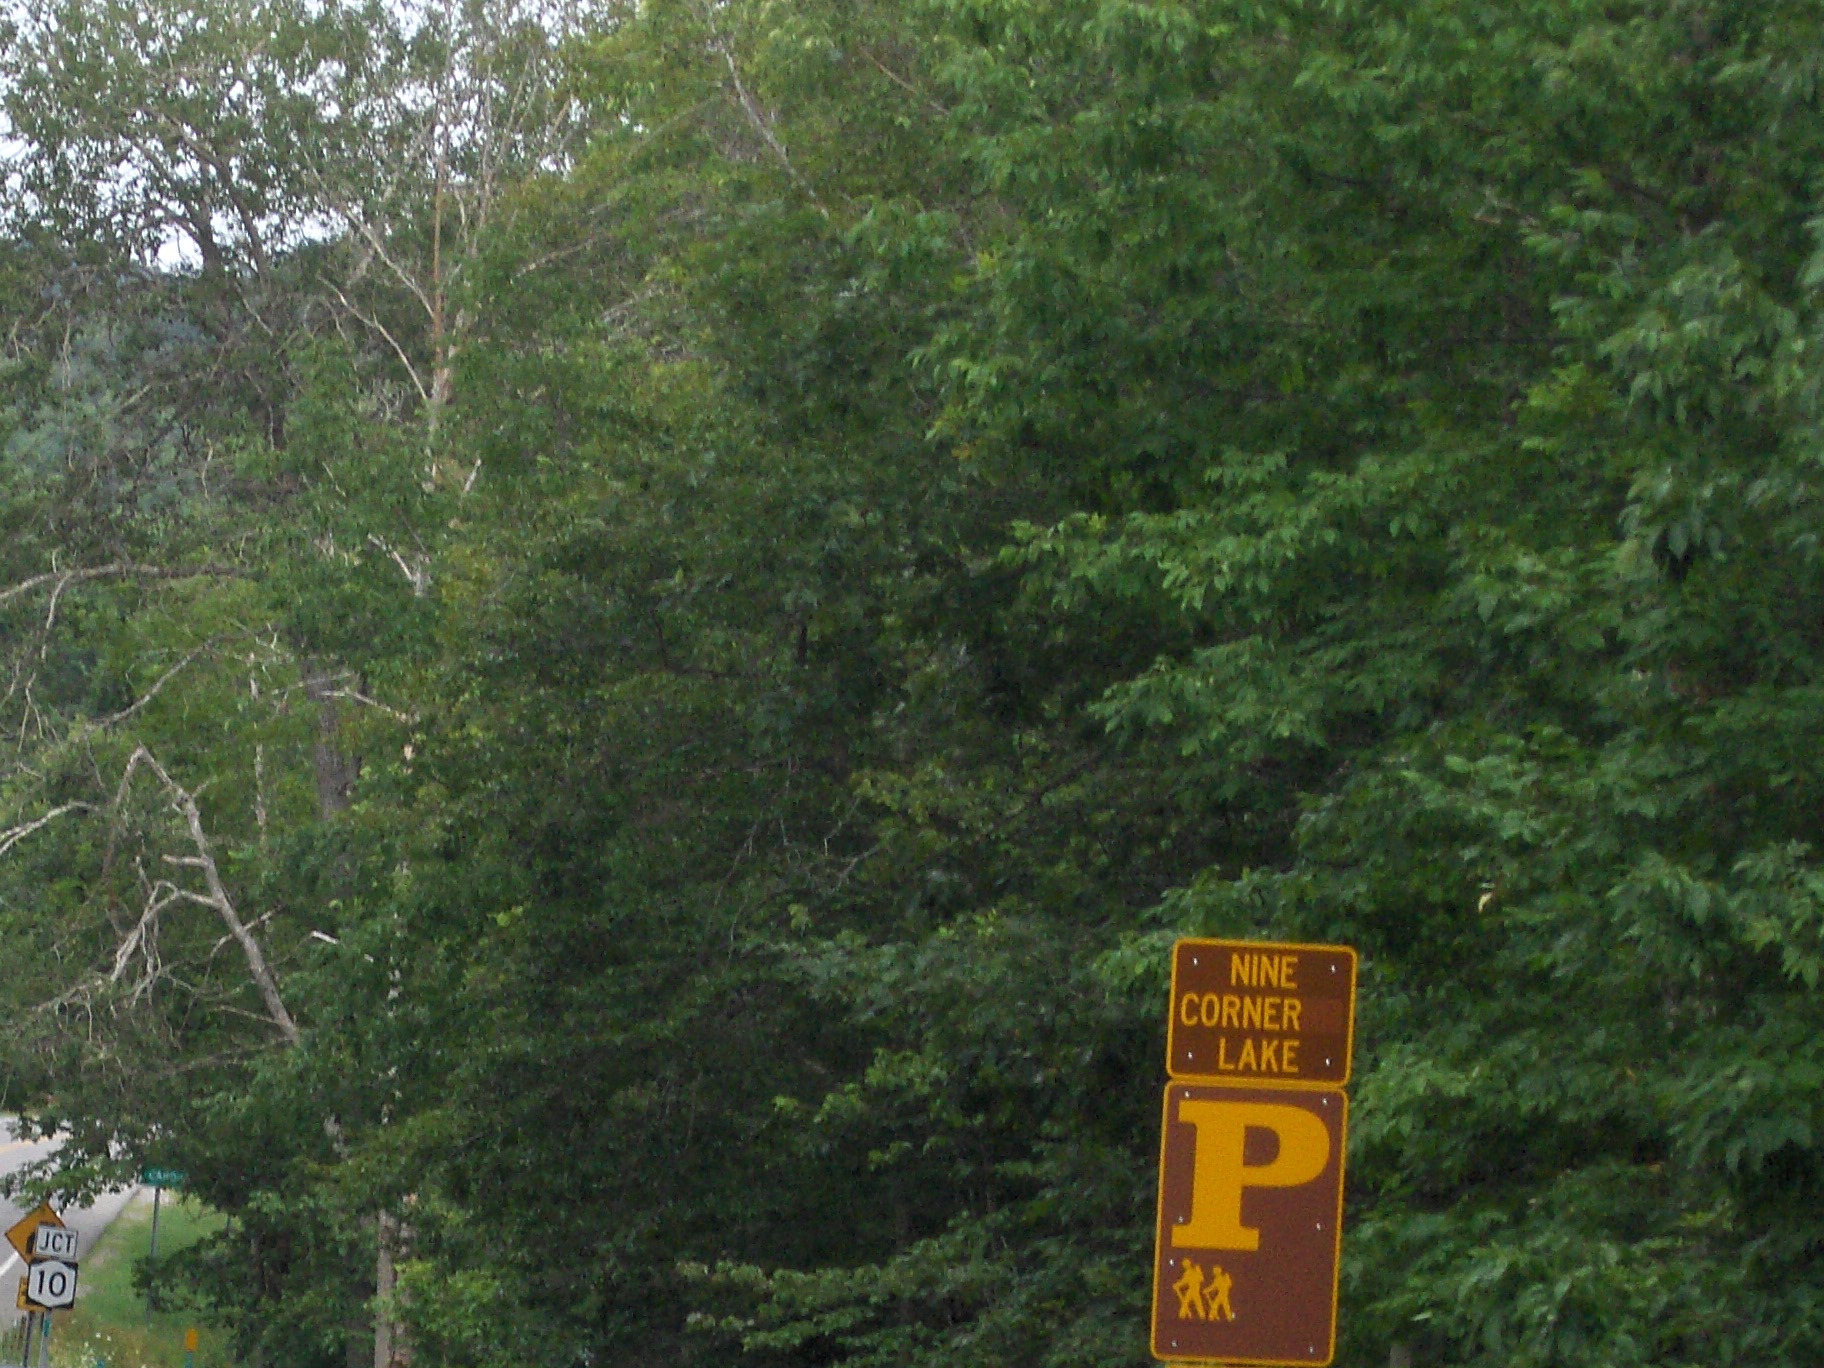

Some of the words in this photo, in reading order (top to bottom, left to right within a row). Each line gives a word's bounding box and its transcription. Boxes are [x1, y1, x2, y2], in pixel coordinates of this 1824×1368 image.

[1230, 952, 1299, 989] NINE
[1180, 992, 1303, 1031] CORNER
[1218, 1037, 1300, 1073] LAKE
[1171, 1099, 1330, 1252] P
[39, 1231, 75, 1254] JCT
[38, 1270, 67, 1297] 10
